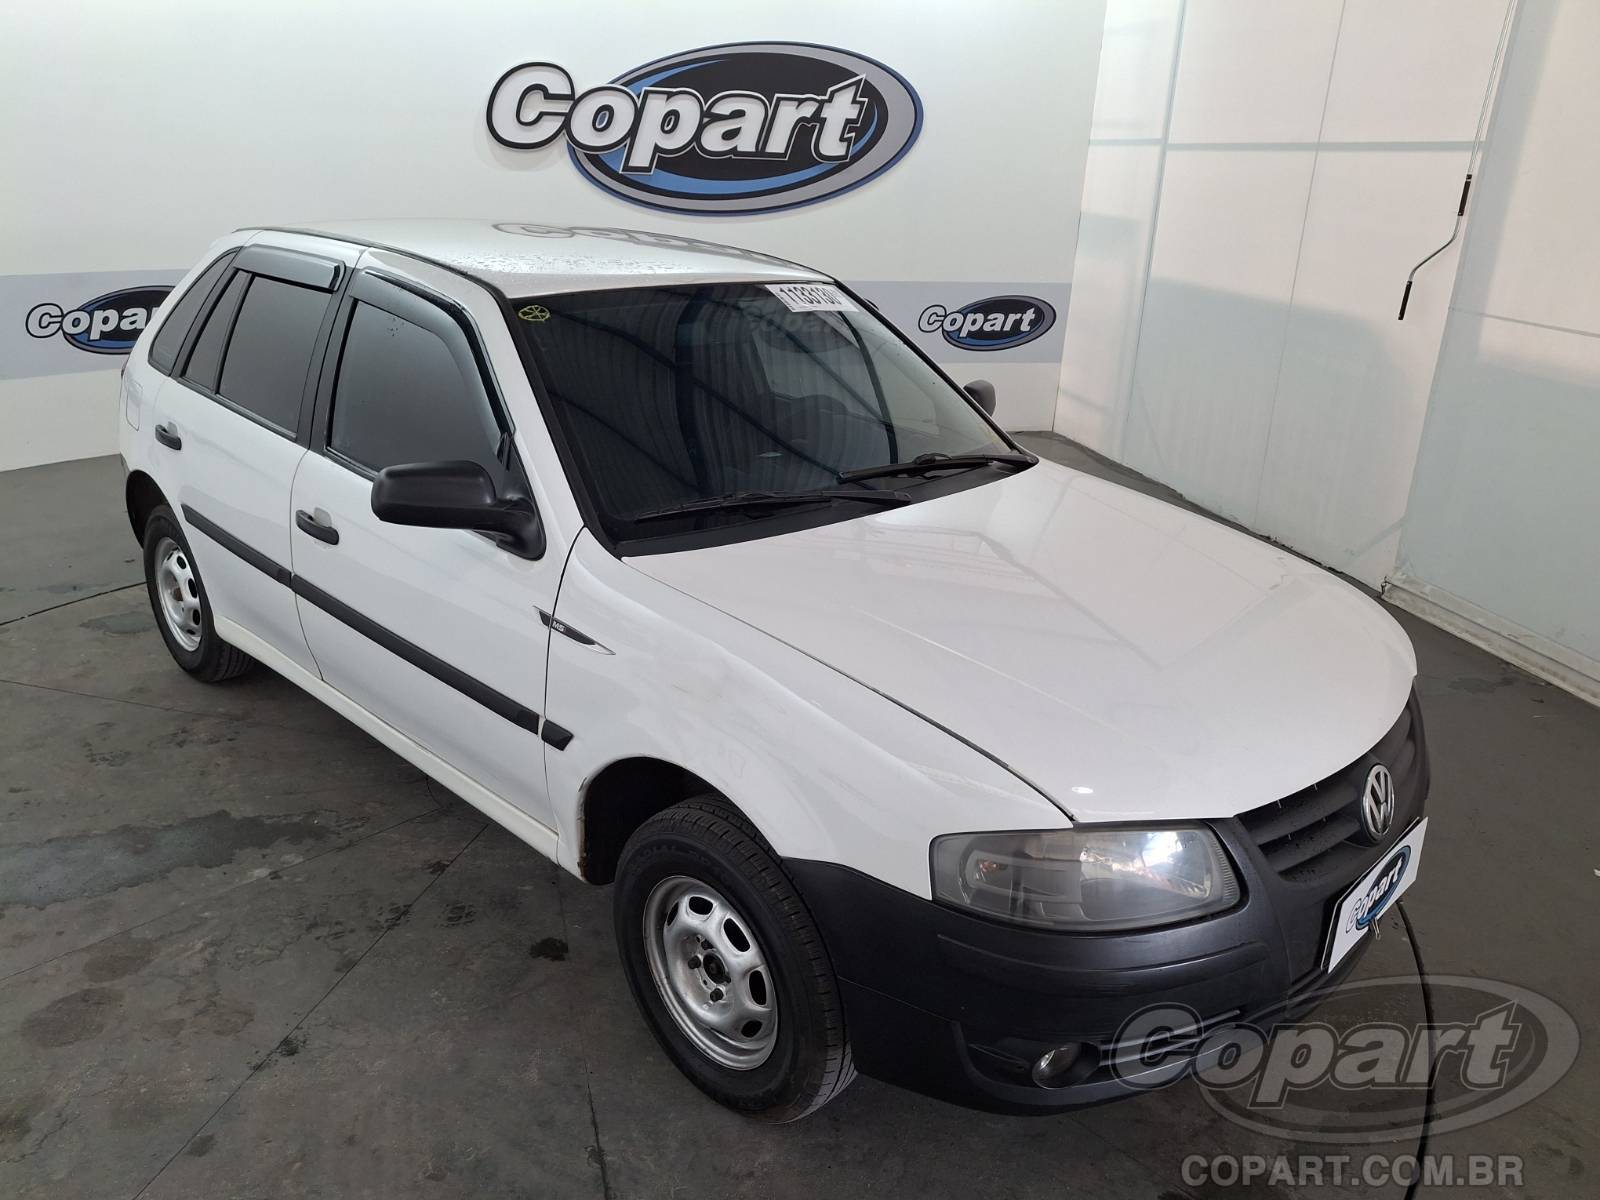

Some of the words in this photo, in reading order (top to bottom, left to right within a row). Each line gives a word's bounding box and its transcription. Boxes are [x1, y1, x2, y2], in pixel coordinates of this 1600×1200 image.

[486, 62, 869, 174] Copart
[26, 303, 160, 340] Copa
[918, 304, 1036, 339] Copart
[1345, 857, 1403, 934] Copart
